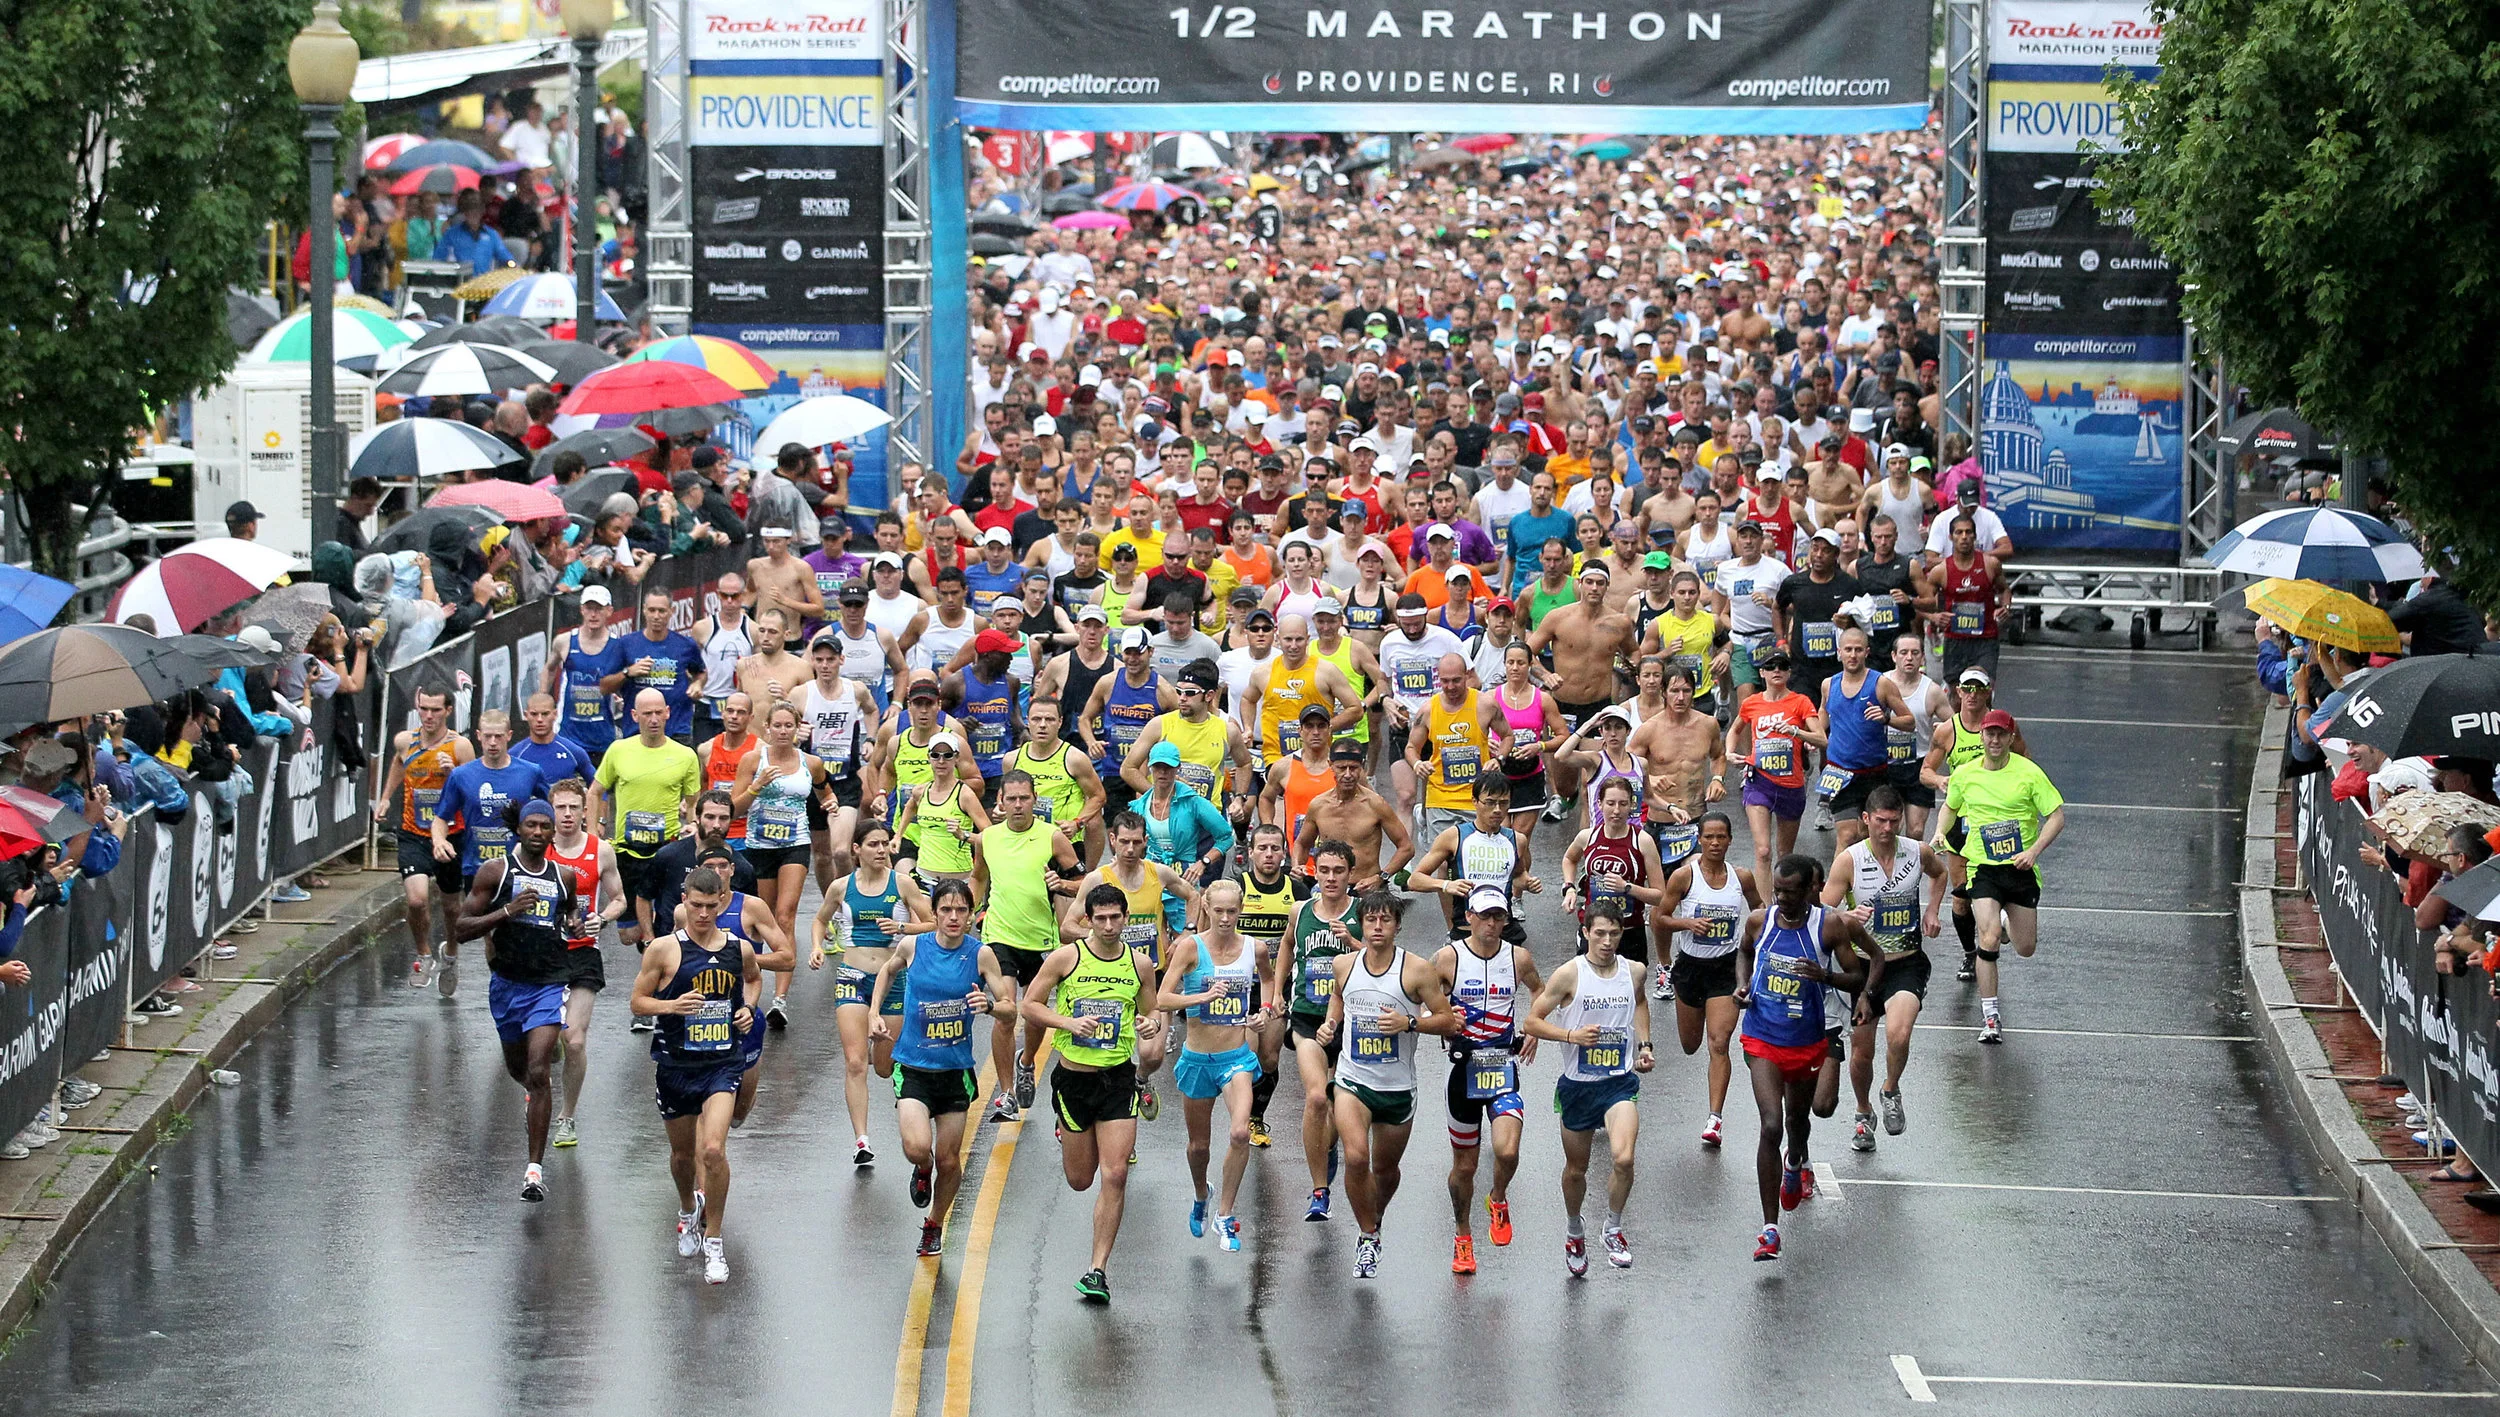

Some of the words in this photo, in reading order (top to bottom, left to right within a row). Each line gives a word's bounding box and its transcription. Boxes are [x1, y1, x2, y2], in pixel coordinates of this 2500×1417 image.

[706, 15, 780, 33] Rock
[806, 15, 868, 33] Roll
[1169, 5, 1257, 38] 1/2
[1306, 9, 1722, 41] MARATHON
[2007, 19, 2083, 38] Rock
[718, 40, 801, 49] MARATHON
[807, 39, 857, 49] SERIES
[2019, 44, 2105, 55] MARATHON
[999, 74, 1159, 98] competitor.com
[1296, 70, 1530, 96] PROVIDENCE,
[1549, 72, 1580, 94] RI
[1728, 77, 1890, 101] competitor.com
[701, 94, 873, 129] PROVIDENCE
[997, 143, 1014, 168] 3
[765, 168, 837, 181] BROOKS
[801, 198, 850, 210] SPORTS
[704, 246, 737, 259] MUSCLE
[742, 246, 767, 259] MILK
[811, 247, 869, 260] GARMIN
[2001, 254, 2037, 268] MUSCLE
[2038, 255, 2063, 268] MILK
[2110, 258, 2169, 270] GARMIN
[2004, 291, 2032, 306] Poland
[2033, 291, 2061, 308] Spring
[740, 328, 840, 344] competitor.com
[2034, 339, 2136, 355] competitor.com
[2254, 438, 2297, 449] Gartmore
[251, 452, 295, 461] SUNBELT
[1352, 610, 1377, 624] 1042
[1957, 616, 1979, 629] 1074
[1807, 639, 1833, 652] 1463
[1402, 676, 1427, 688] 1120
[575, 703, 600, 716] 1234
[968, 704, 1009, 714] WHIPPETS
[1111, 707, 1156, 719] WHIPPETS
[817, 712, 848, 721] FLEET
[1757, 712, 1785, 726] FAST
[819, 720, 847, 729] FEET
[976, 740, 999, 754] 1181
[1448, 763, 1476, 777] 1509
[1760, 756, 1788, 770] 1436
[1820, 773, 1843, 791] 1126
[630, 829, 659, 844] 1489
[763, 824, 791, 841] 1231
[479, 846, 507, 860] 2475
[1470, 845, 1509, 859] ROBIN
[1990, 838, 2017, 856] 1457
[1468, 858, 1505, 873] HOOD
[1593, 859, 1623, 873] GVH
[884, 895, 897, 903] NB
[1239, 918, 1268, 928] TEAM
[1882, 910, 1910, 927] 1189
[692, 969, 737, 996] NAVY
[1077, 976, 1134, 986] BROOKS
[1767, 975, 1800, 996] 1602
[1461, 988, 1485, 996] IRON
[1081, 1005, 1117, 1015] PROVIDENCE
[1209, 998, 1242, 1015] 1620
[1350, 998, 1374, 1008] Willow
[687, 1023, 729, 1042] 15400
[926, 1020, 963, 1041] 4450
[1357, 1037, 1392, 1055] 1604
[1475, 1071, 1506, 1090] 1075
